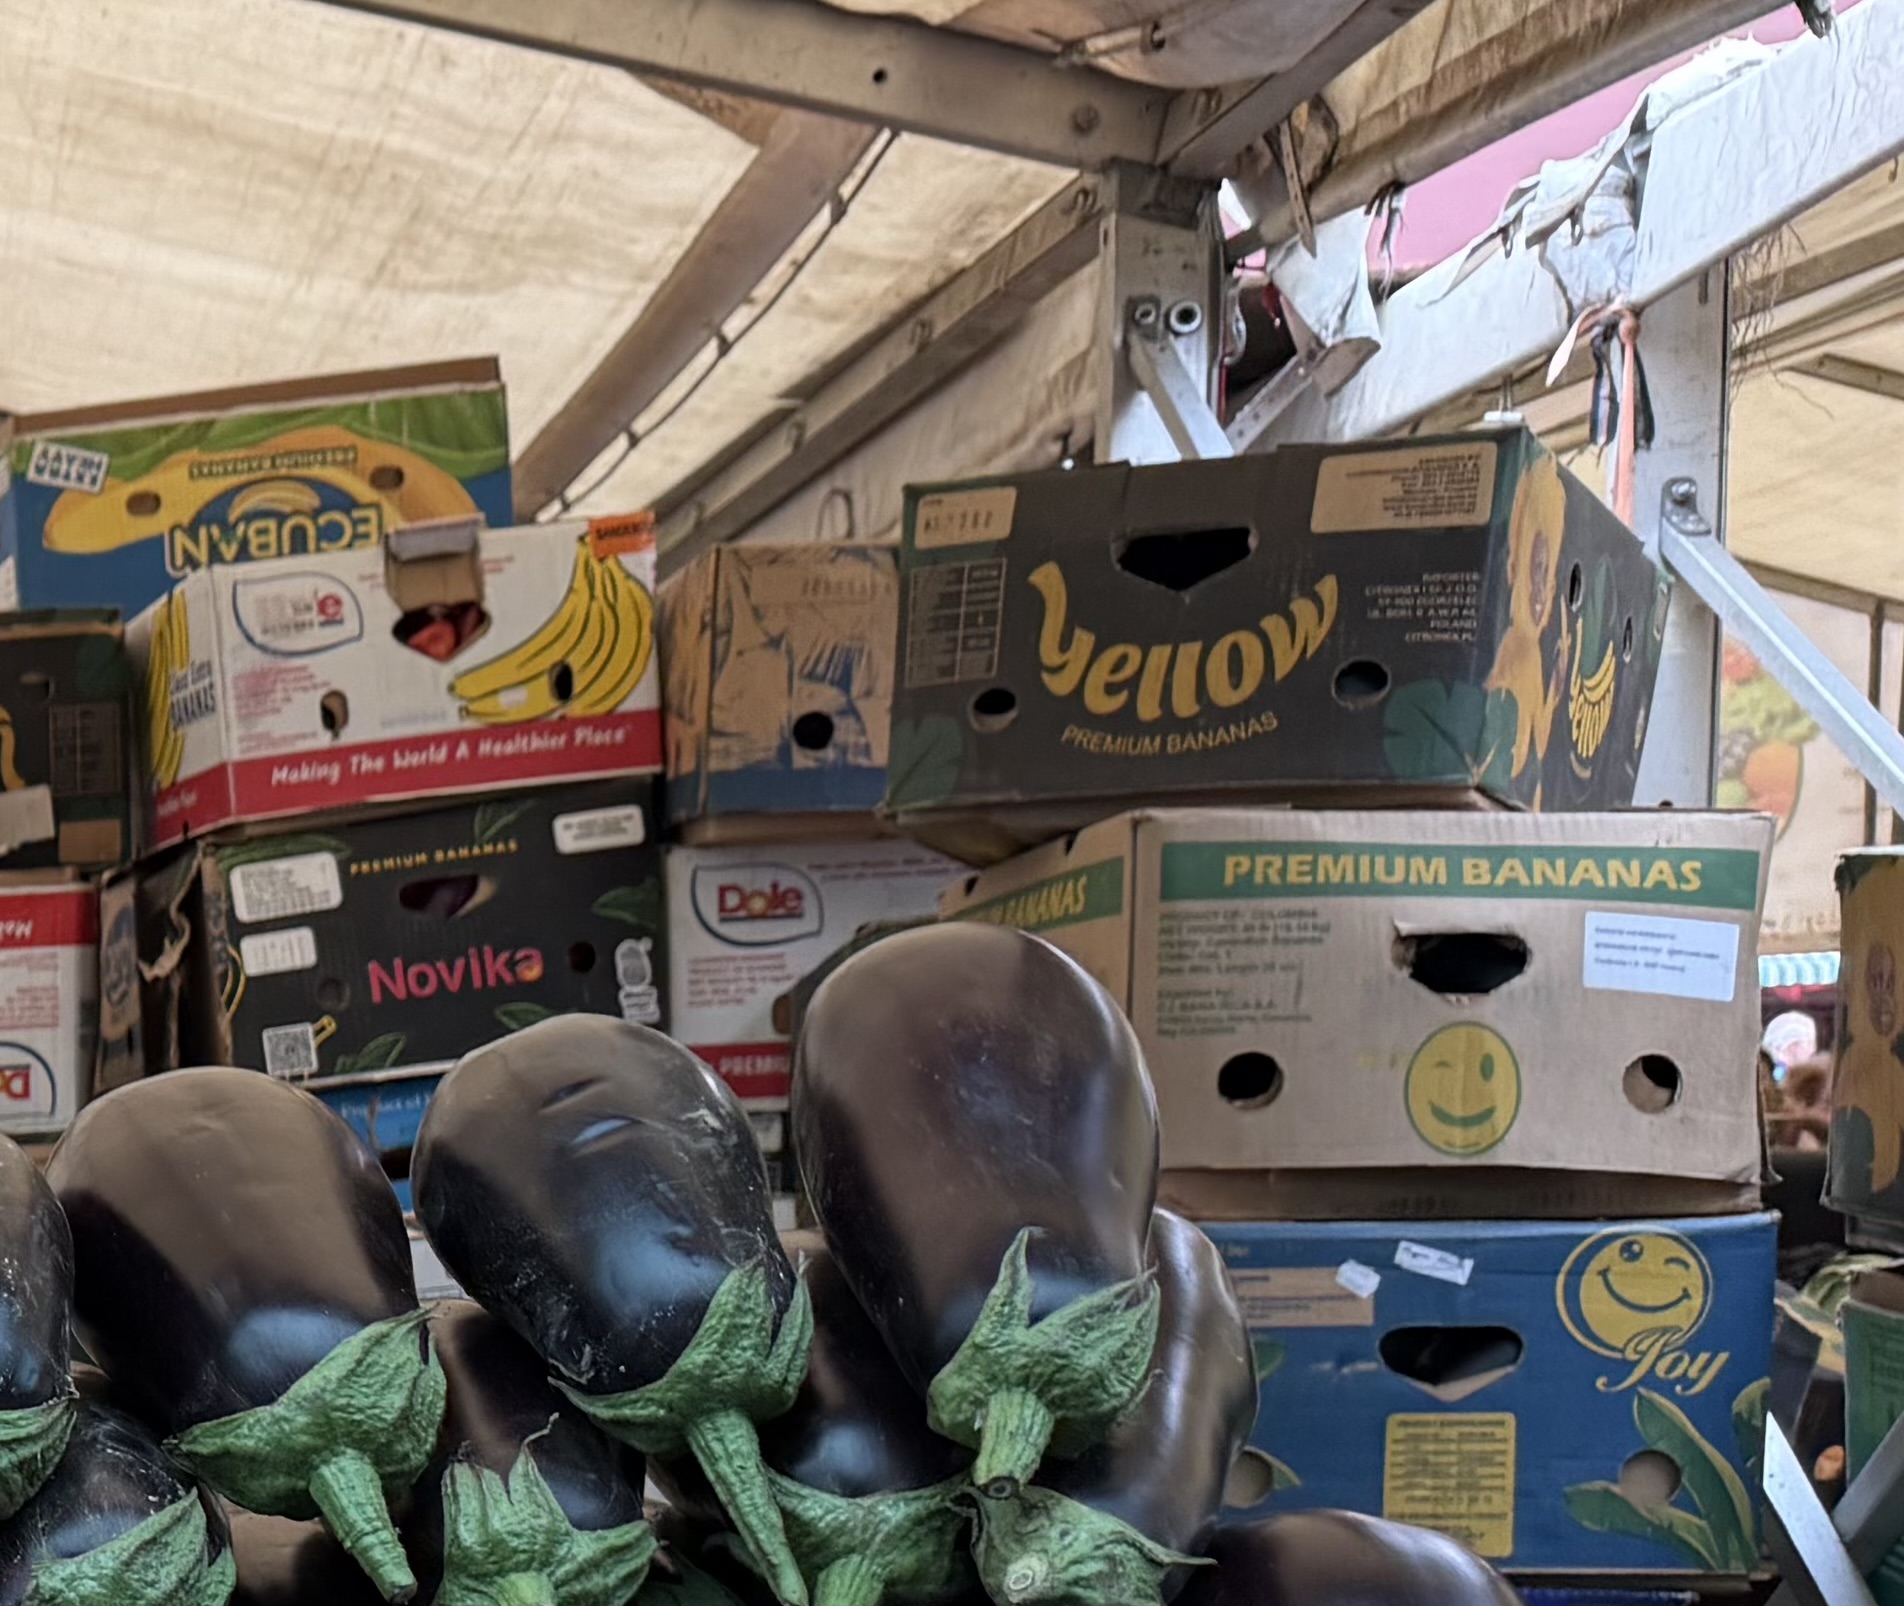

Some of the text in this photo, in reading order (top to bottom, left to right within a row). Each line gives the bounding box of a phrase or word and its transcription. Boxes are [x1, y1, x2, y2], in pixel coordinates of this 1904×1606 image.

[1061, 710, 1279, 756] PREMIUM BANANAS
[271, 723, 627, 789] Making The World A Healthier Place
[350, 839, 519, 876] PREMIUM BANANAS
[1223, 852, 1703, 893] PREMIUM BANANAS
[718, 878, 805, 914] Dole
[1596, 1325, 1730, 1396] Joy
